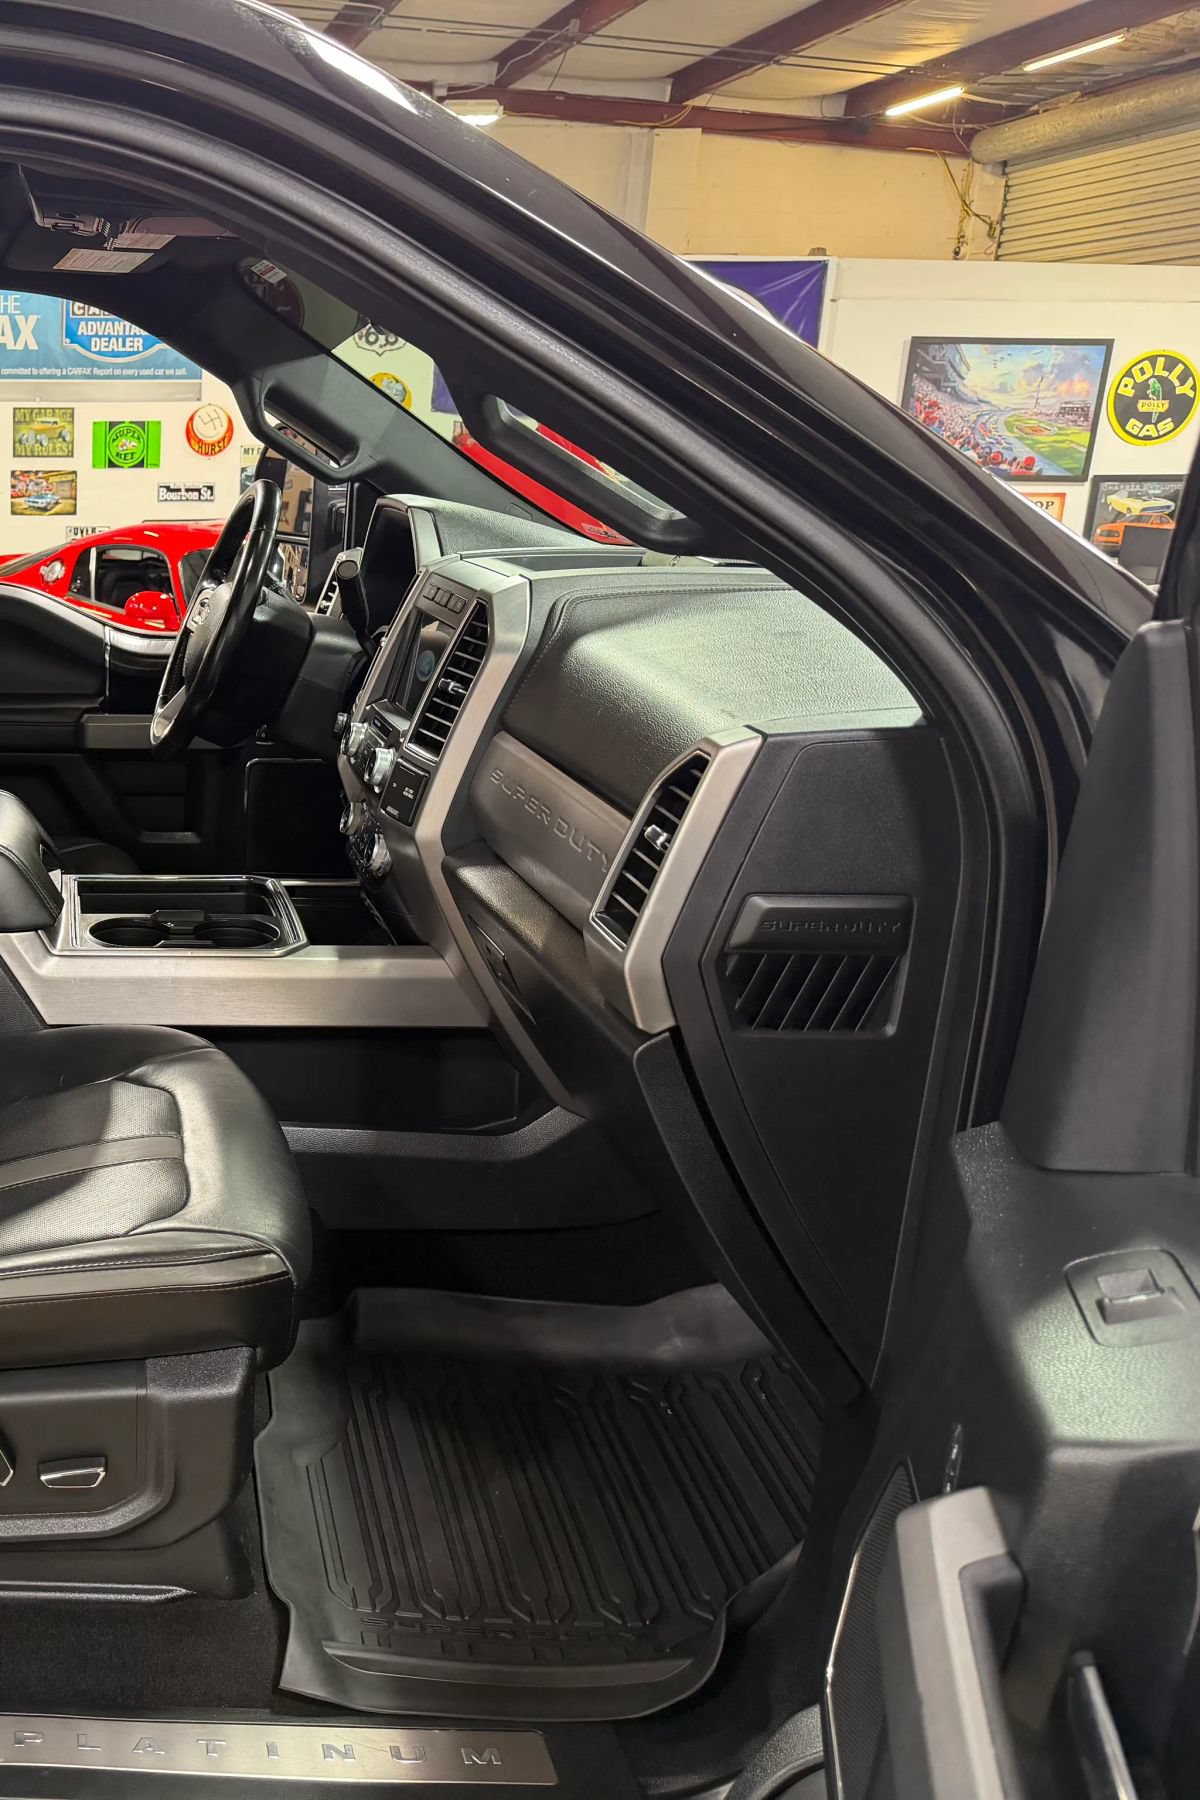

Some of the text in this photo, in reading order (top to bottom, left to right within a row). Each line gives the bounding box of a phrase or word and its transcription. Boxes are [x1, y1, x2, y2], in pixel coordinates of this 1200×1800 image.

[77, 321, 149, 336] ADVANTA
[90, 337, 144, 352] DEALER
[1117, 357, 1195, 399] POLLY
[15, 408, 72, 421] MY GARAGE
[1125, 417, 1175, 437] GAS
[112, 428, 141, 442] SUPER
[15, 443, 32, 456] MY
[198, 436, 227, 455] HURST
[243, 447, 255, 456] MY
[159, 487, 214, 501] Bourbon St.
[489, 766, 613, 873] SUPER DUTY
[13, 1730, 502, 1766] PLATINUM
